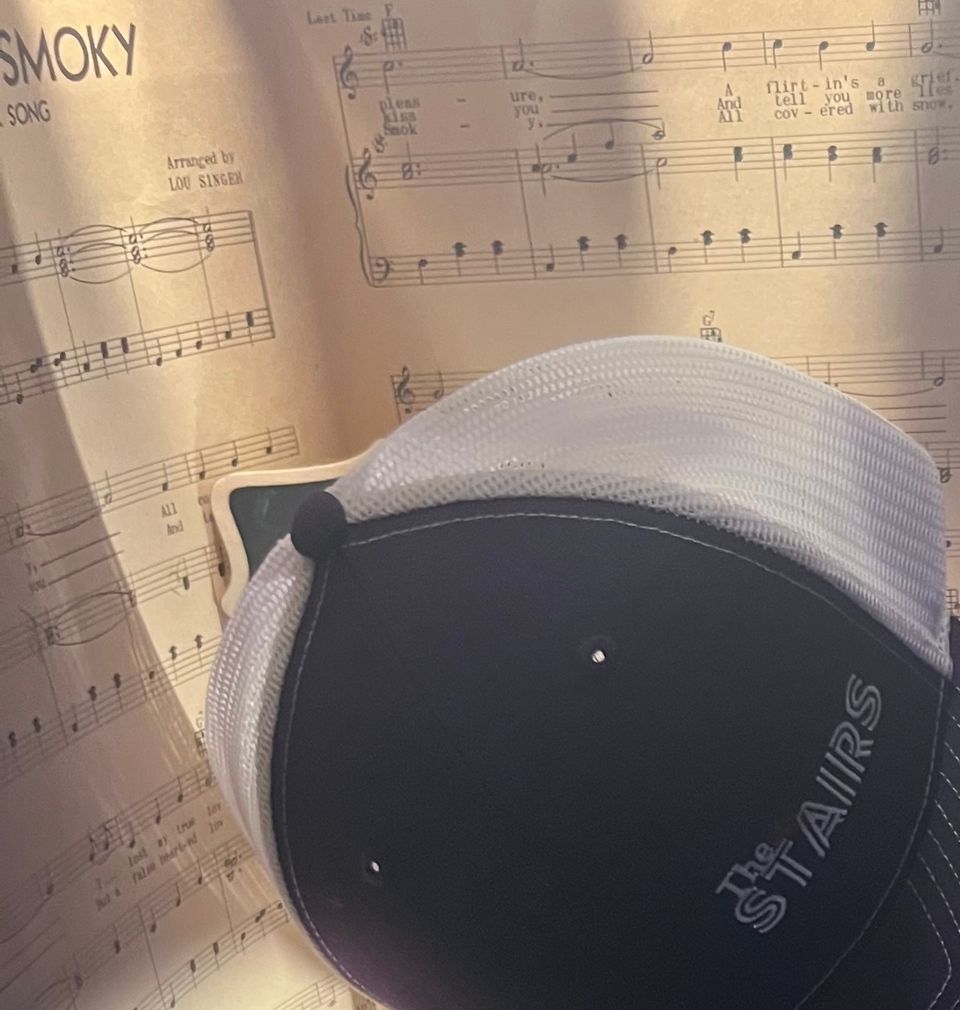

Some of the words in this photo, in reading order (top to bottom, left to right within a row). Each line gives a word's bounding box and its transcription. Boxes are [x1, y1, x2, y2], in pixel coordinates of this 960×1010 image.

[306, 10, 337, 25] Last
[342, 8, 373, 23] Time
[0, 22, 136, 87] SMOKY
[716, 96, 743, 111] And
[774, 92, 807, 107] tell
[825, 91, 851, 108] you
[865, 86, 903, 101] more
[7, 100, 51, 126] SONG
[514, 104, 540, 119] you
[717, 109, 744, 124] All
[868, 99, 905, 114] with
[167, 151, 217, 170] Arranged
[220, 150, 236, 165] by
[168, 176, 192, 192] LOU
[199, 171, 244, 190] SINGER
[734, 673, 882, 934] STAIRS
[715, 842, 777, 898] The
